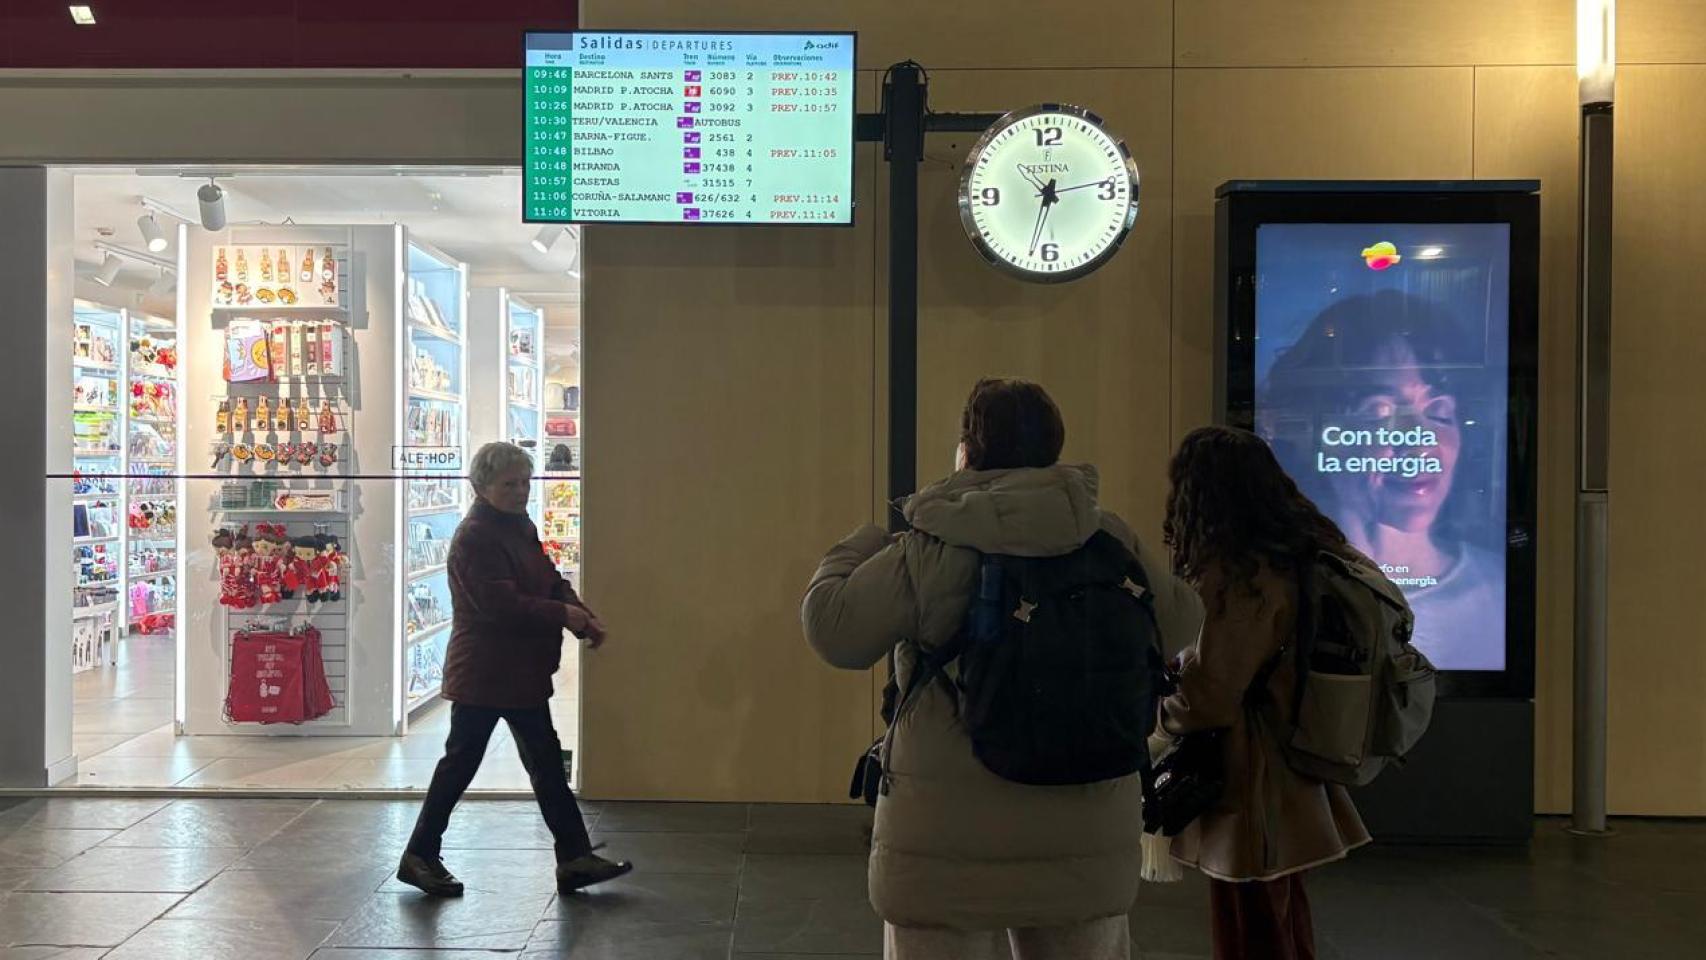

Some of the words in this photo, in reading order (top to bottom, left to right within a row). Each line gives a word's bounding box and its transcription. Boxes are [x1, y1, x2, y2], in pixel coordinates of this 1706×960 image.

[580, 37, 643, 49] Salidas
[652, 41, 733, 51] DEPARTURES
[534, 70, 567, 79] 09:46
[574, 70, 633, 80] BARCELONA
[640, 72, 674, 80] SANTS
[710, 72, 736, 80] 3083
[772, 73, 837, 81] PREV.10:42
[534, 86, 567, 94] 10:09
[574, 86, 613, 94] MADRID
[621, 86, 674, 95] P.ATOCHA
[710, 87, 736, 96] 6090
[747, 88, 753, 96] 3
[772, 88, 837, 97] PREV.10:35
[534, 102, 567, 110] 10:26
[574, 102, 613, 110] MADRID
[621, 103, 674, 111] P.ATOCHA
[709, 103, 735, 111] 3092
[746, 104, 753, 112] 3
[772, 104, 837, 112] PREV.10:57
[534, 117, 567, 125] 10:30
[572, 117, 658, 127] TERU/VALENCIA
[695, 118, 741, 127] AUTOBUS
[534, 133, 566, 141] 10:47
[574, 133, 651, 141] BARNA-FIGUE.
[709, 134, 735, 142] 2561
[1032, 128, 1063, 146] 12
[534, 147, 567, 156] 10:48
[574, 147, 613, 156] BILBAO
[716, 149, 735, 157] 438
[746, 150, 752, 158] 4
[770, 150, 837, 158] PREV.11:05
[534, 162, 567, 170] 10:48
[574, 162, 620, 171] MIRANDA
[703, 164, 735, 172] 37438
[746, 164, 752, 172] 4
[534, 177, 567, 186] 10:57
[574, 177, 620, 186] CASETAS
[703, 179, 735, 187] 31515
[1098, 181, 1116, 200] 3
[534, 192, 567, 200] 11:06
[572, 190, 671, 201] CORUÑA-SALAMANC
[695, 194, 740, 203] 626/632
[774, 194, 839, 203] PREV.11:14
[982, 188, 1000, 206] 9
[534, 208, 567, 216] 11:06
[574, 208, 620, 217] VITORIA
[703, 210, 735, 218] 37626
[770, 210, 835, 219] PREV.11:14
[1041, 243, 1059, 262] 6
[1322, 426, 1372, 447] Con
[1376, 425, 1438, 447] toda
[1317, 452, 1341, 473] la
[1346, 452, 1442, 477] energía
